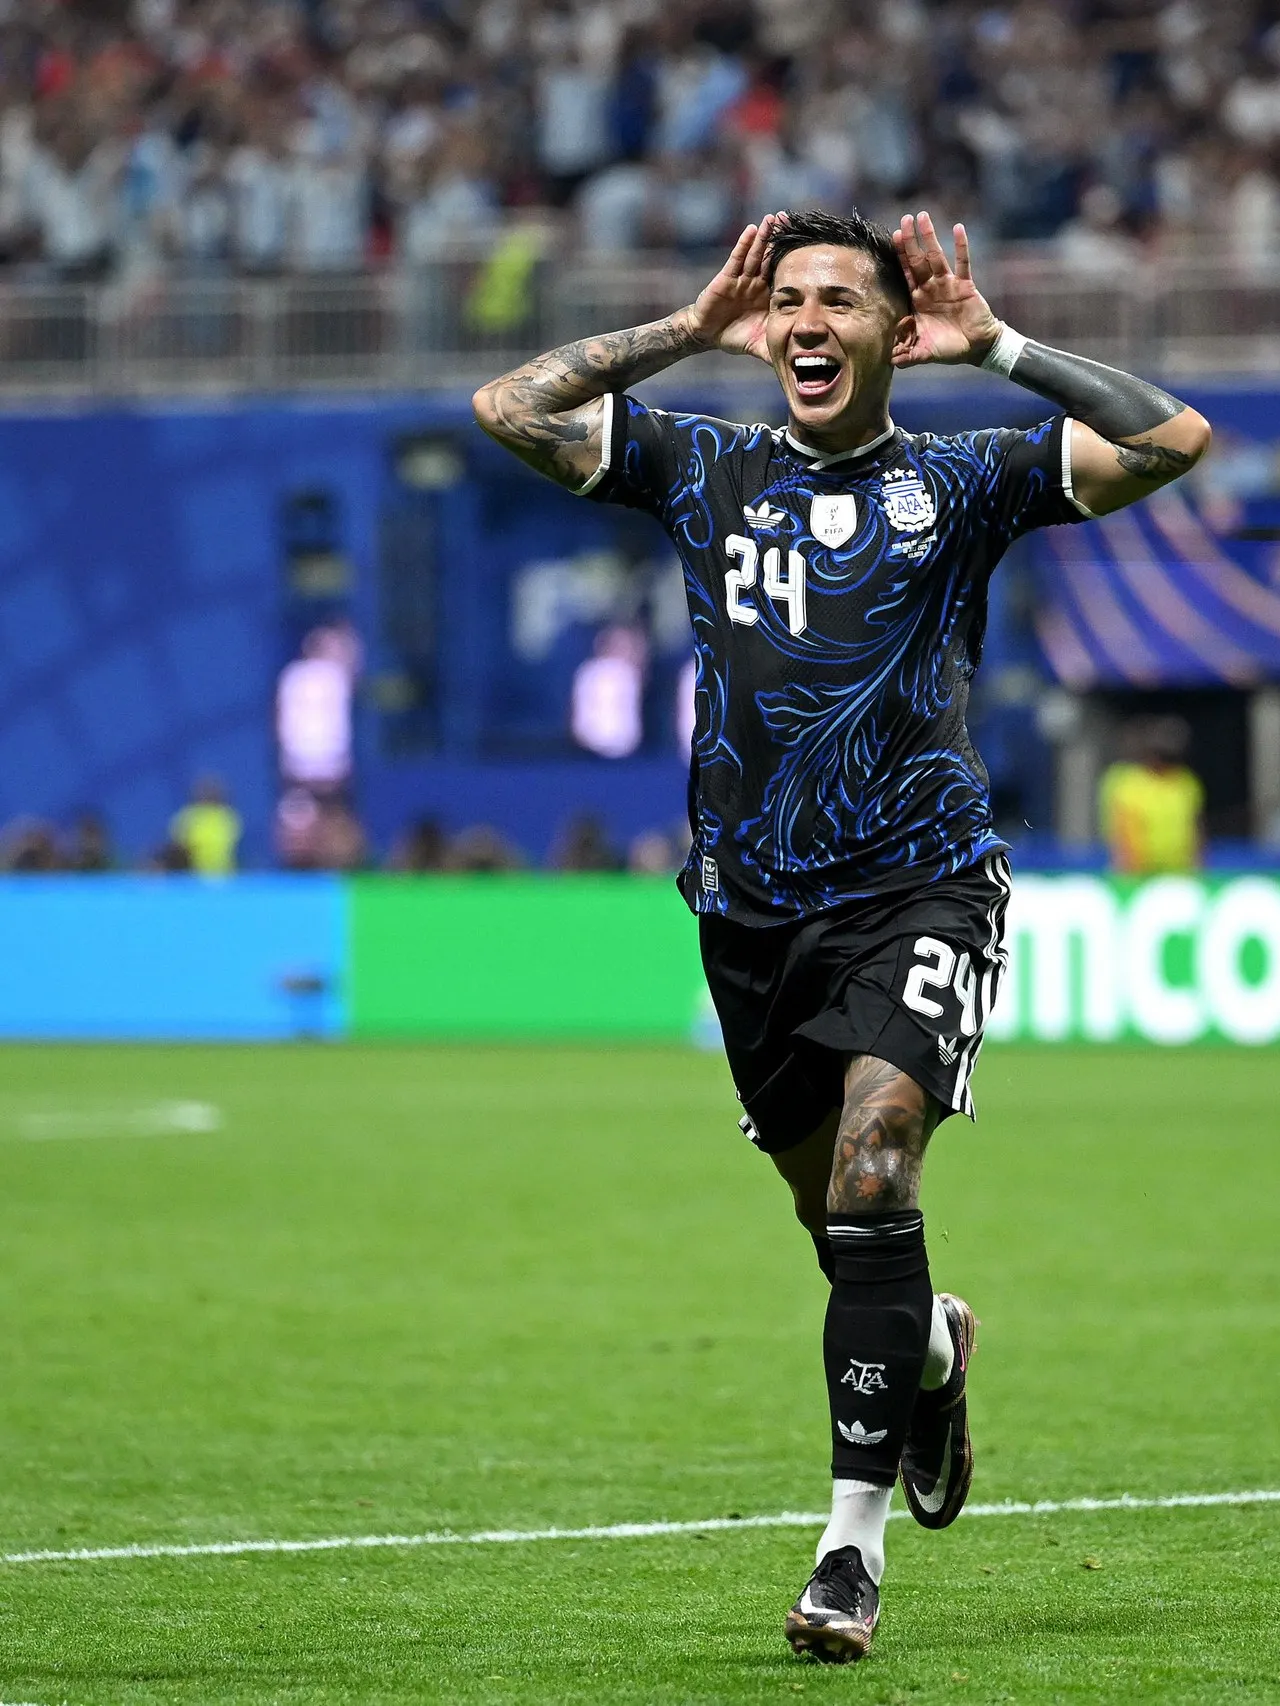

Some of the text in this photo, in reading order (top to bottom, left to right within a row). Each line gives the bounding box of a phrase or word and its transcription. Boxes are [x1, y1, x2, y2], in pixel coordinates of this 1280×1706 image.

[898, 493, 924, 515] AFA
[824, 527, 844, 535] FIFA
[724, 534, 807, 636] 24
[901, 935, 978, 1038] 24
[840, 1357, 889, 1396] AFA
